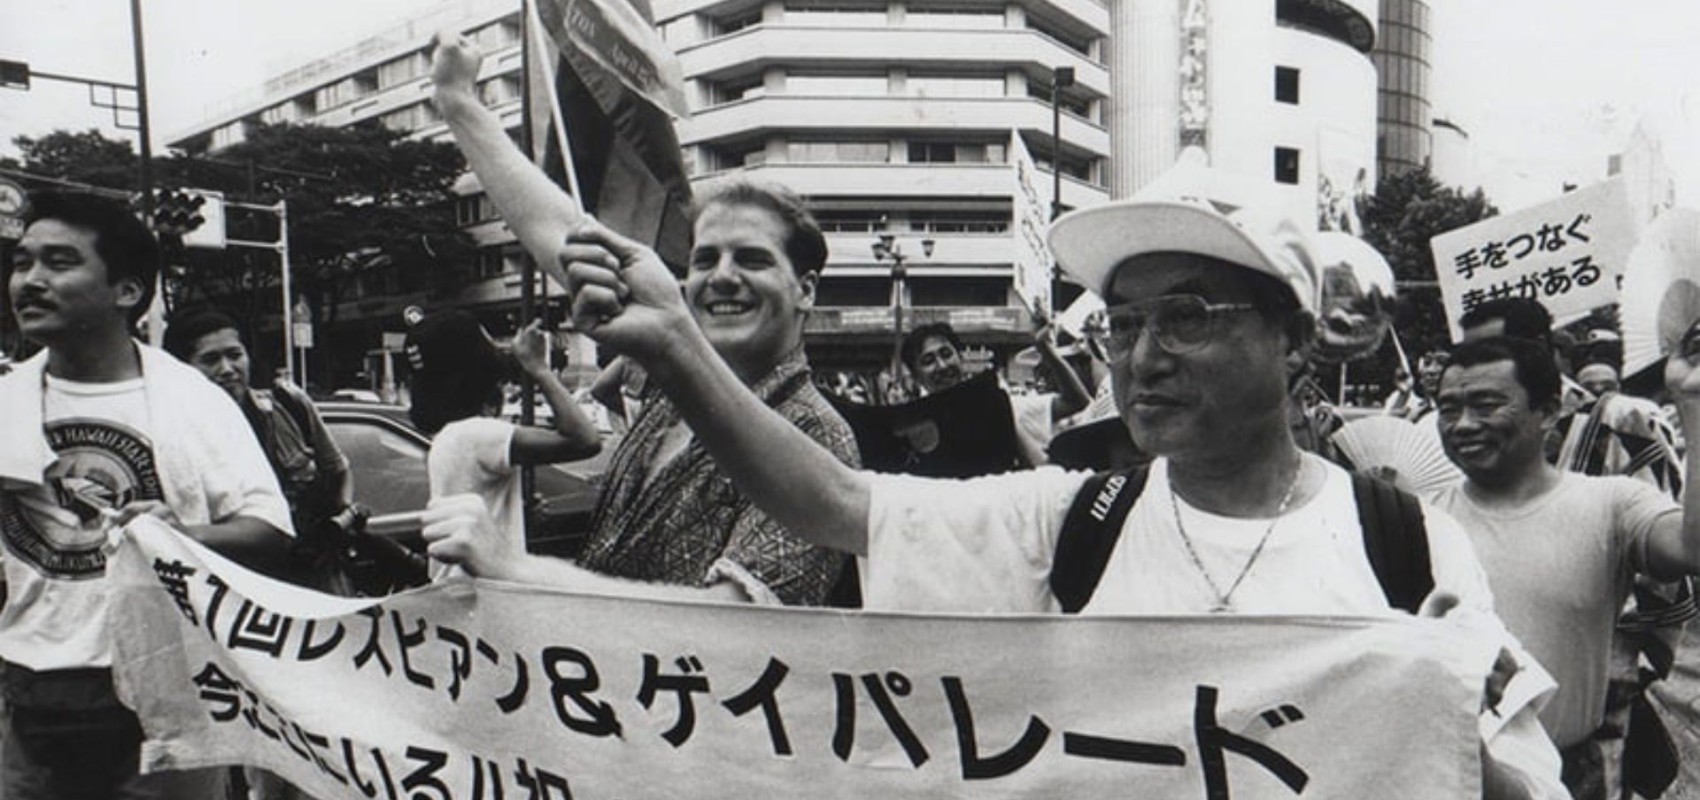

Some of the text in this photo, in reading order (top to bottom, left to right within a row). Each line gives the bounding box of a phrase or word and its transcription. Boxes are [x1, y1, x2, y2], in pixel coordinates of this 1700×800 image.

[1454, 213, 1592, 280] 手をつなぐ
[1461, 255, 1602, 312] 幸せがある
[65, 428, 120, 447] HAWAII
